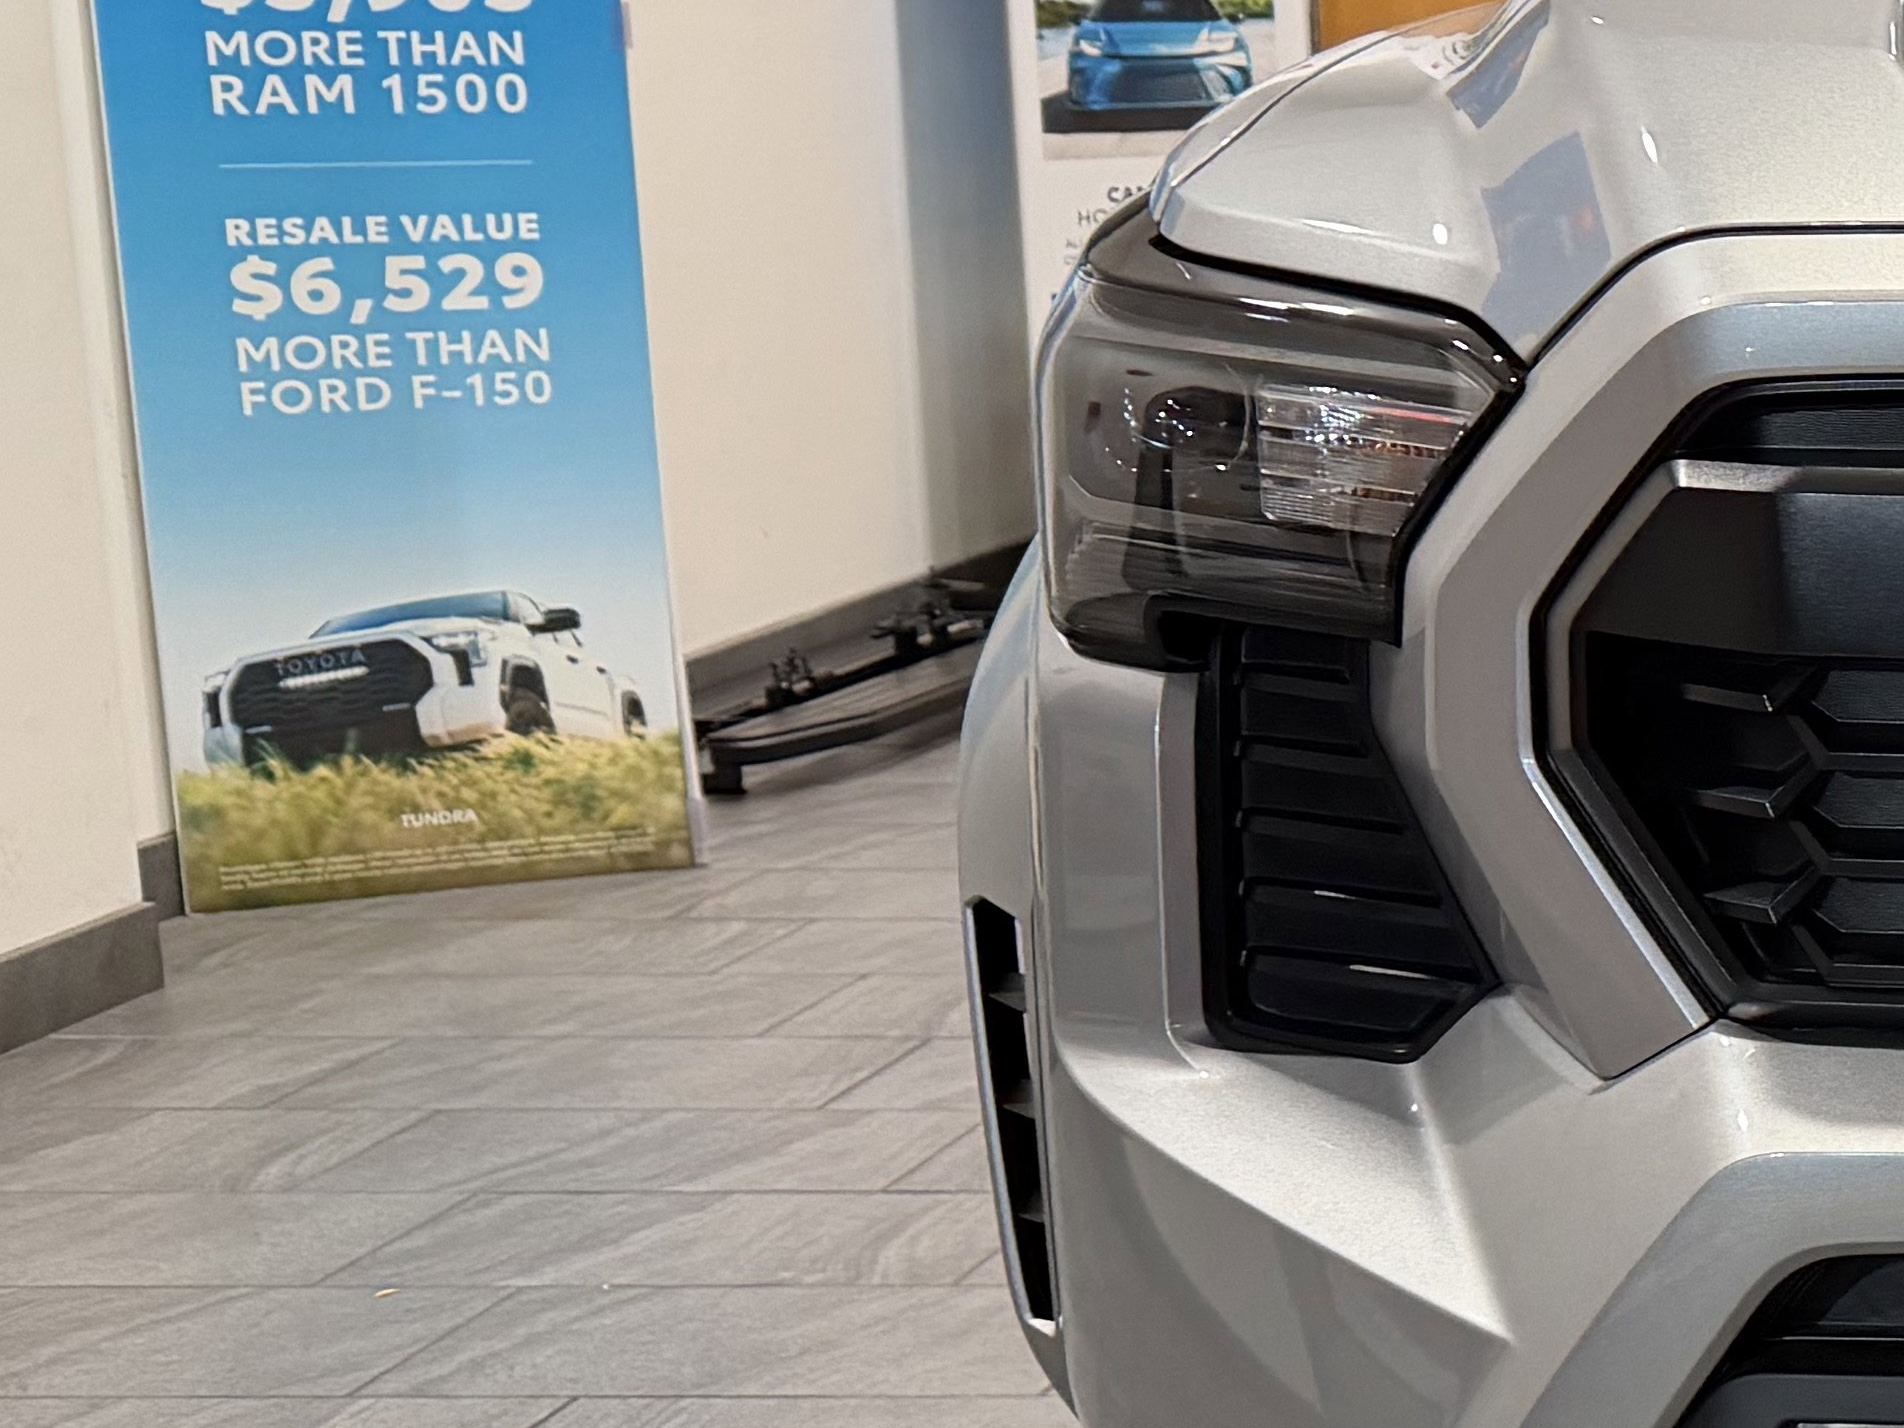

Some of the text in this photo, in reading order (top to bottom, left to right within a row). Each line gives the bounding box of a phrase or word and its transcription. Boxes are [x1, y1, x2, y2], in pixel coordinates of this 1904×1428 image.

[204, 30, 526, 66] MORE THAN
[209, 73, 529, 115] RAM 1500
[224, 212, 541, 247] RESALE VALUE
[229, 252, 545, 326] $6,529
[234, 328, 552, 374] MORE THAN
[238, 370, 553, 417] FORD F-150
[399, 808, 478, 828] TUNDRA
